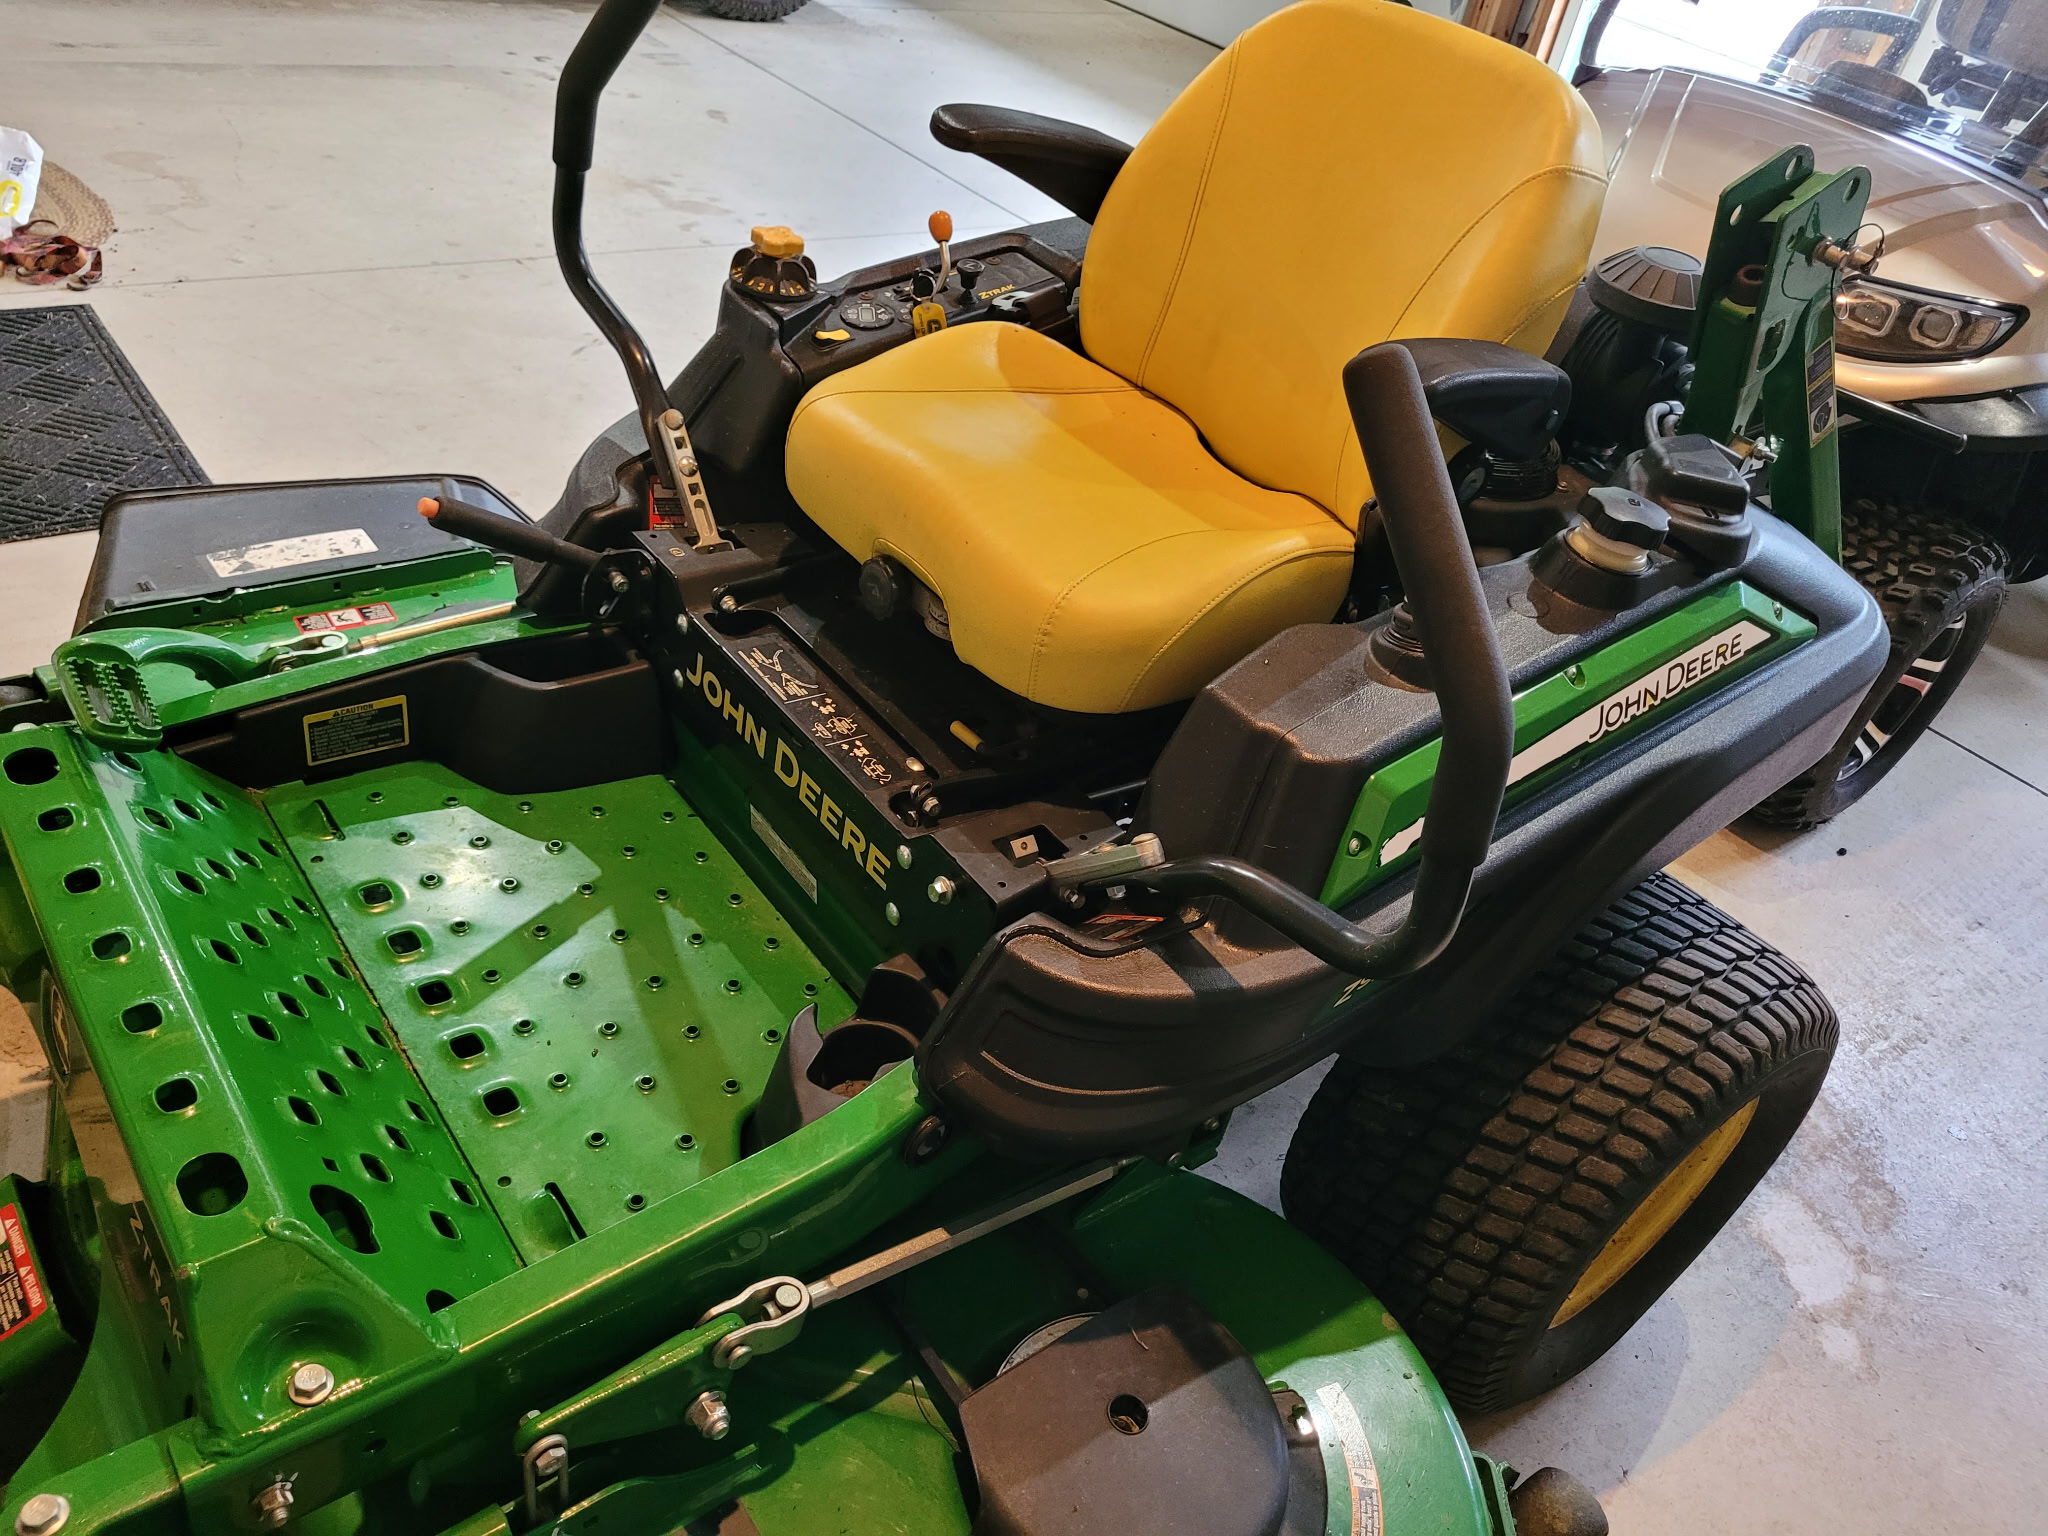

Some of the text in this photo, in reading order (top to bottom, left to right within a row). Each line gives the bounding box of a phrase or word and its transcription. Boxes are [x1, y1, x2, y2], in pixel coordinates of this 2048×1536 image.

[977, 283, 1016, 300] ZTRAK
[1588, 633, 1743, 740] JOHN DEERE
[340, 703, 374, 715] CAUTION
[686, 652, 767, 759] JOHN
[774, 737, 891, 891] DEERE
[8, 1225, 26, 1258] DANGER
[24, 1273, 42, 1308] PELIGRO
